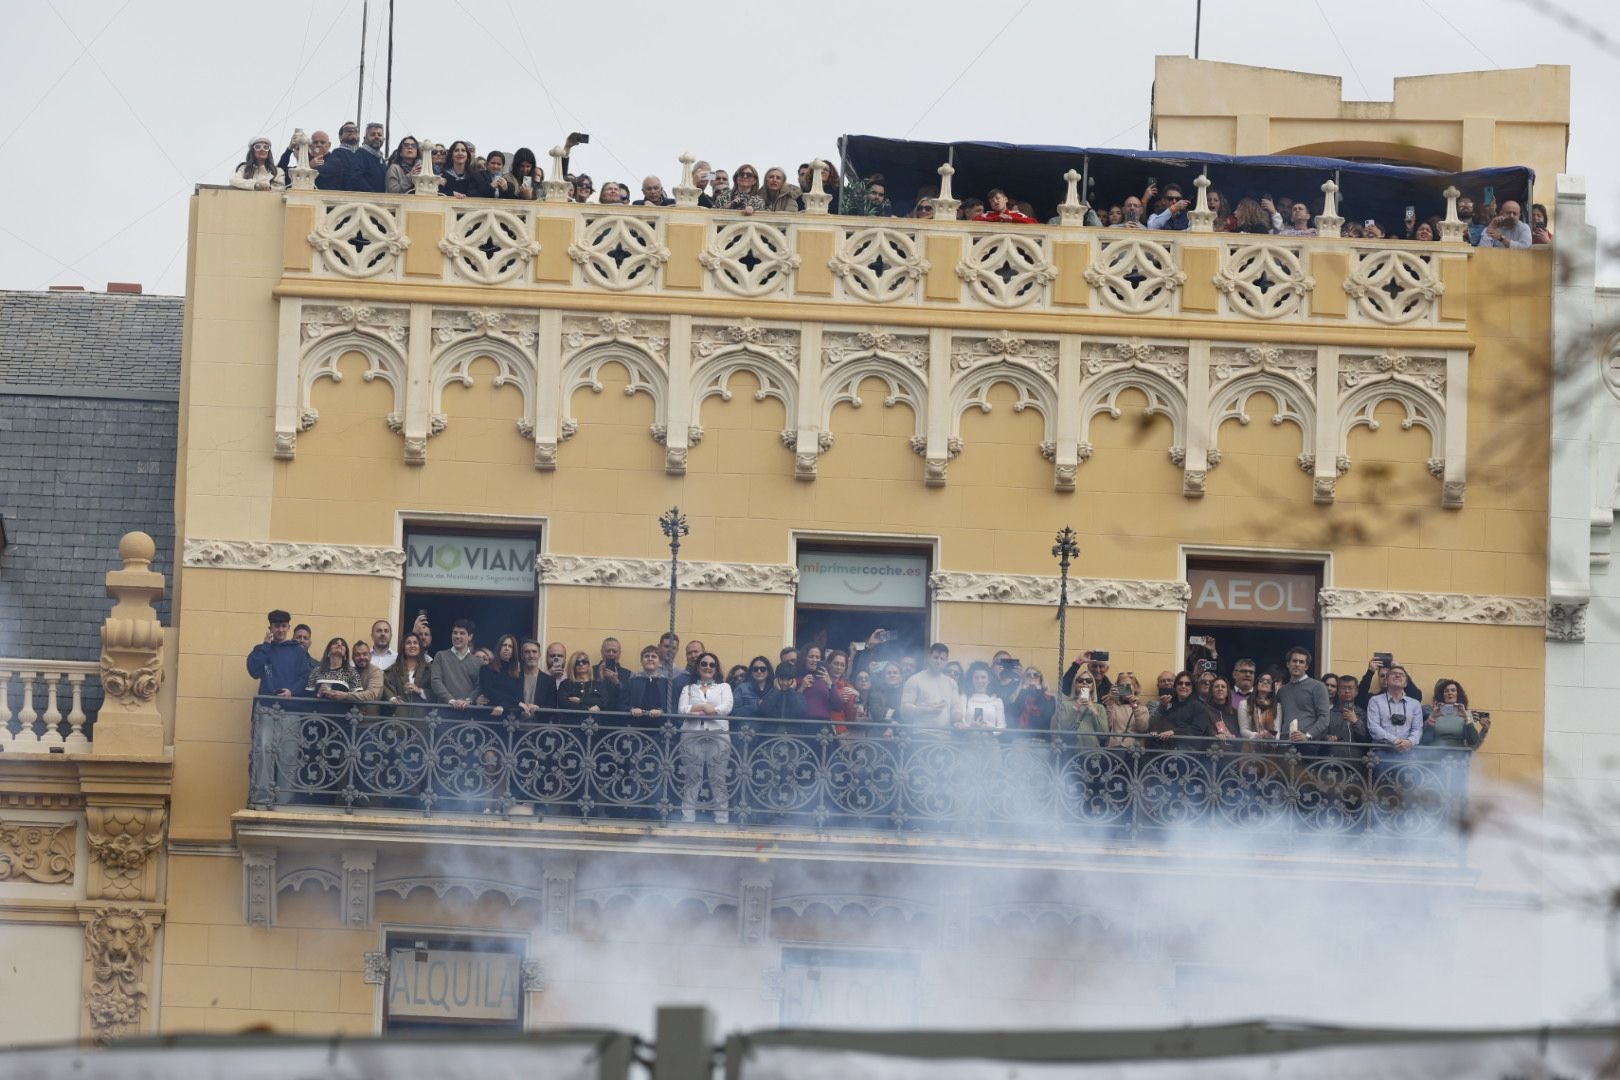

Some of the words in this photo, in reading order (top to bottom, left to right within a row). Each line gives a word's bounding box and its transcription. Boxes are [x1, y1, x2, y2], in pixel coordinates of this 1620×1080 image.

[407, 543, 535, 572] MOVIAM
[803, 562, 921, 577] miprimercoche.es
[1195, 578, 1308, 612] AEOL
[391, 959, 518, 1013] ALQUILA
